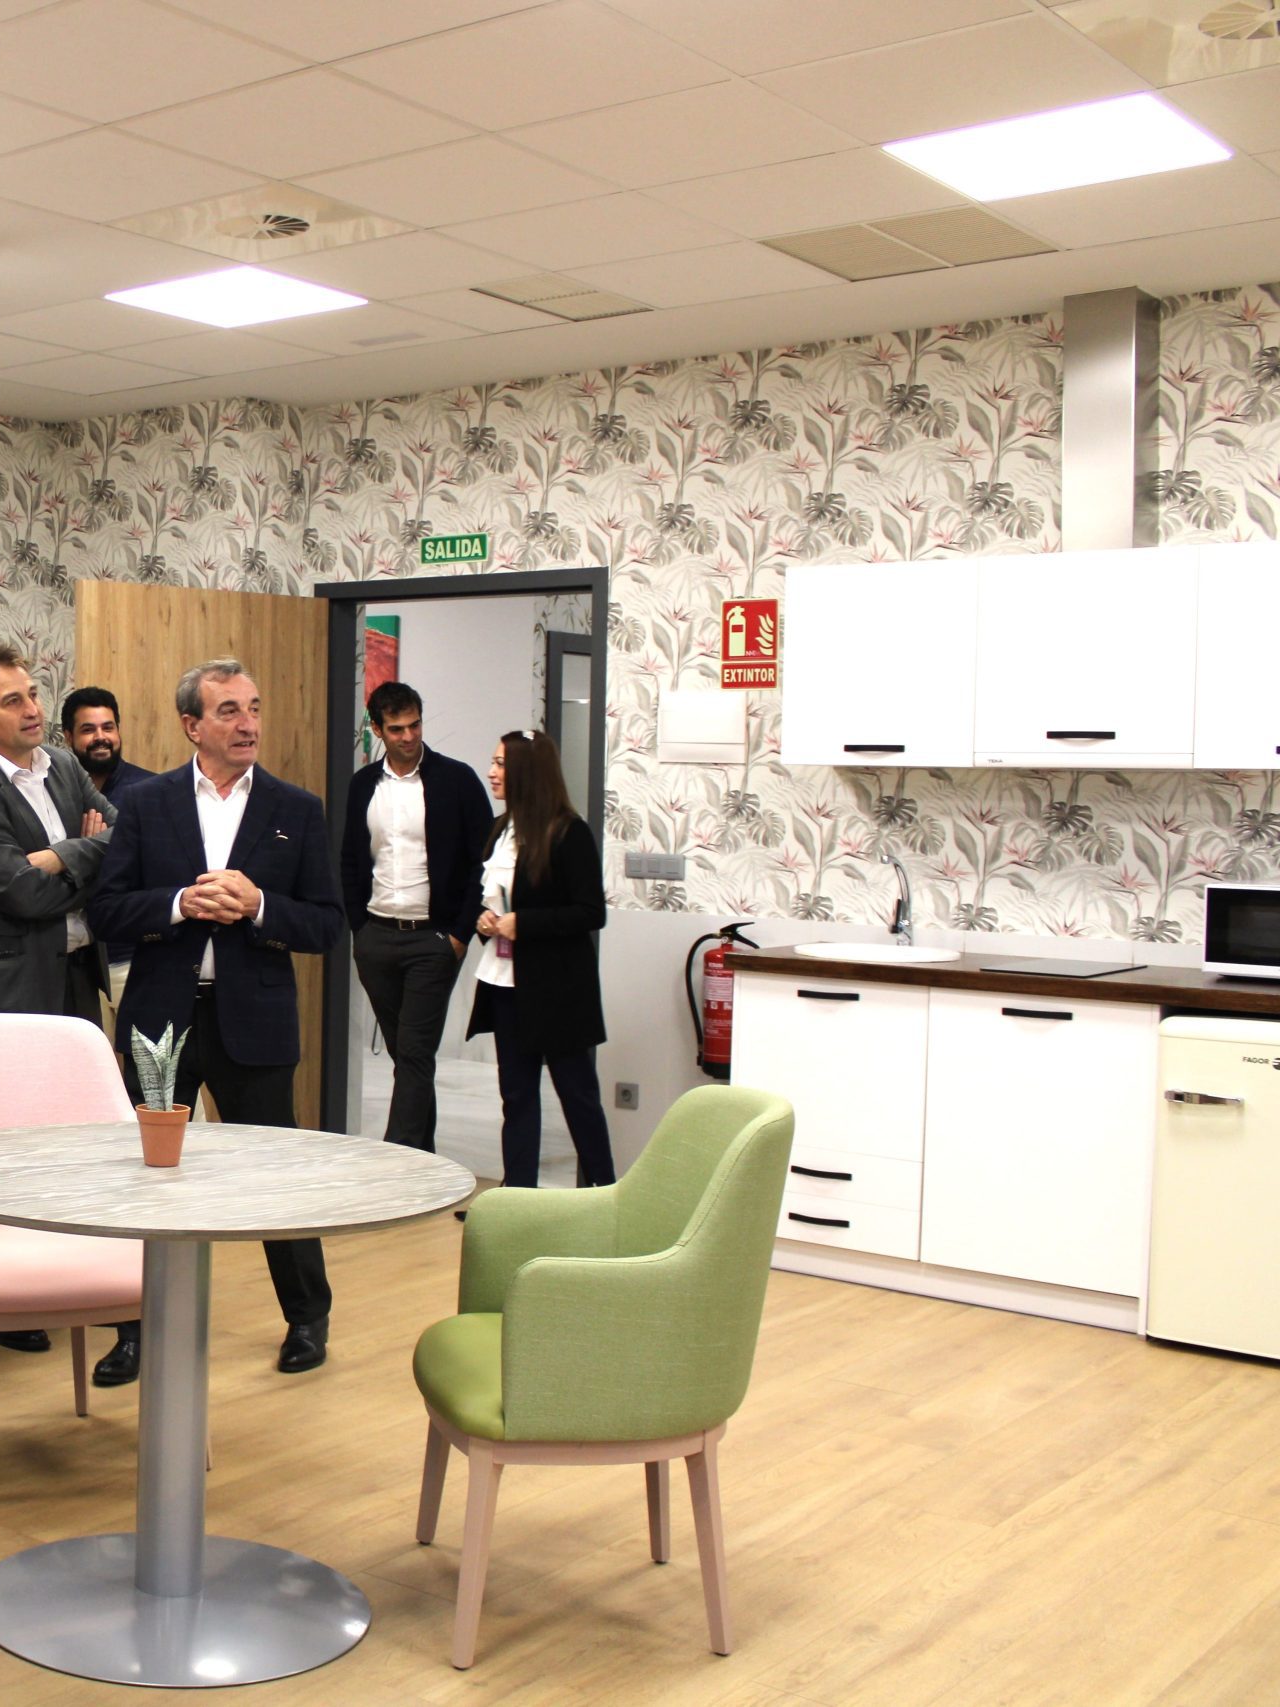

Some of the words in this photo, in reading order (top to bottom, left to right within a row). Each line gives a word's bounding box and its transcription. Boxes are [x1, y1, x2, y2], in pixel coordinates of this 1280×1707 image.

[425, 538, 482, 560] SALIDA
[723, 668, 775, 682] EXTINTOR
[1242, 1056, 1270, 1064] FAGOR
